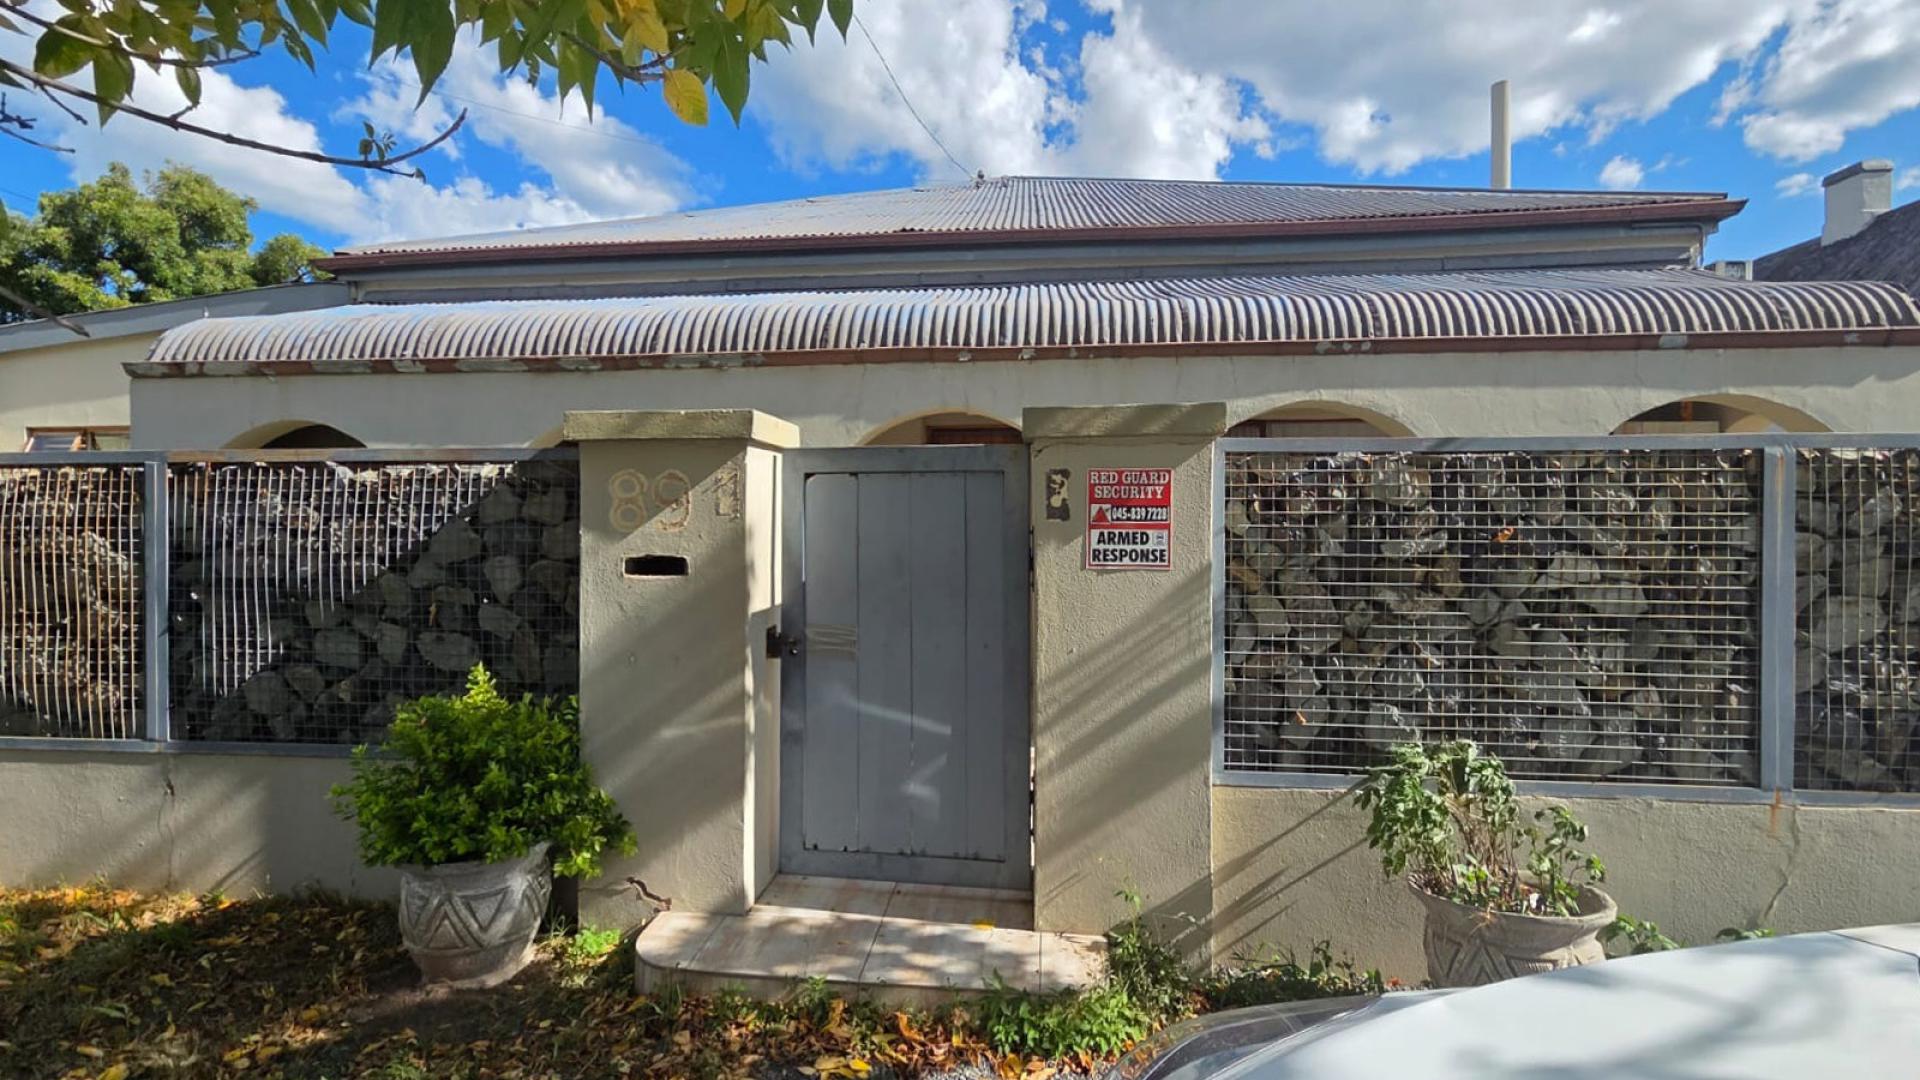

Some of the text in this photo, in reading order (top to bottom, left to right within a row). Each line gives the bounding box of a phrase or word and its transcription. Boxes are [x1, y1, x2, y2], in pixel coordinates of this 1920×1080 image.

[1090, 471, 1169, 484] RED GUARD
[1094, 485, 1165, 499] SECURITY
[1097, 531, 1150, 546] ARMED
[1092, 548, 1167, 563] RESPONSE
